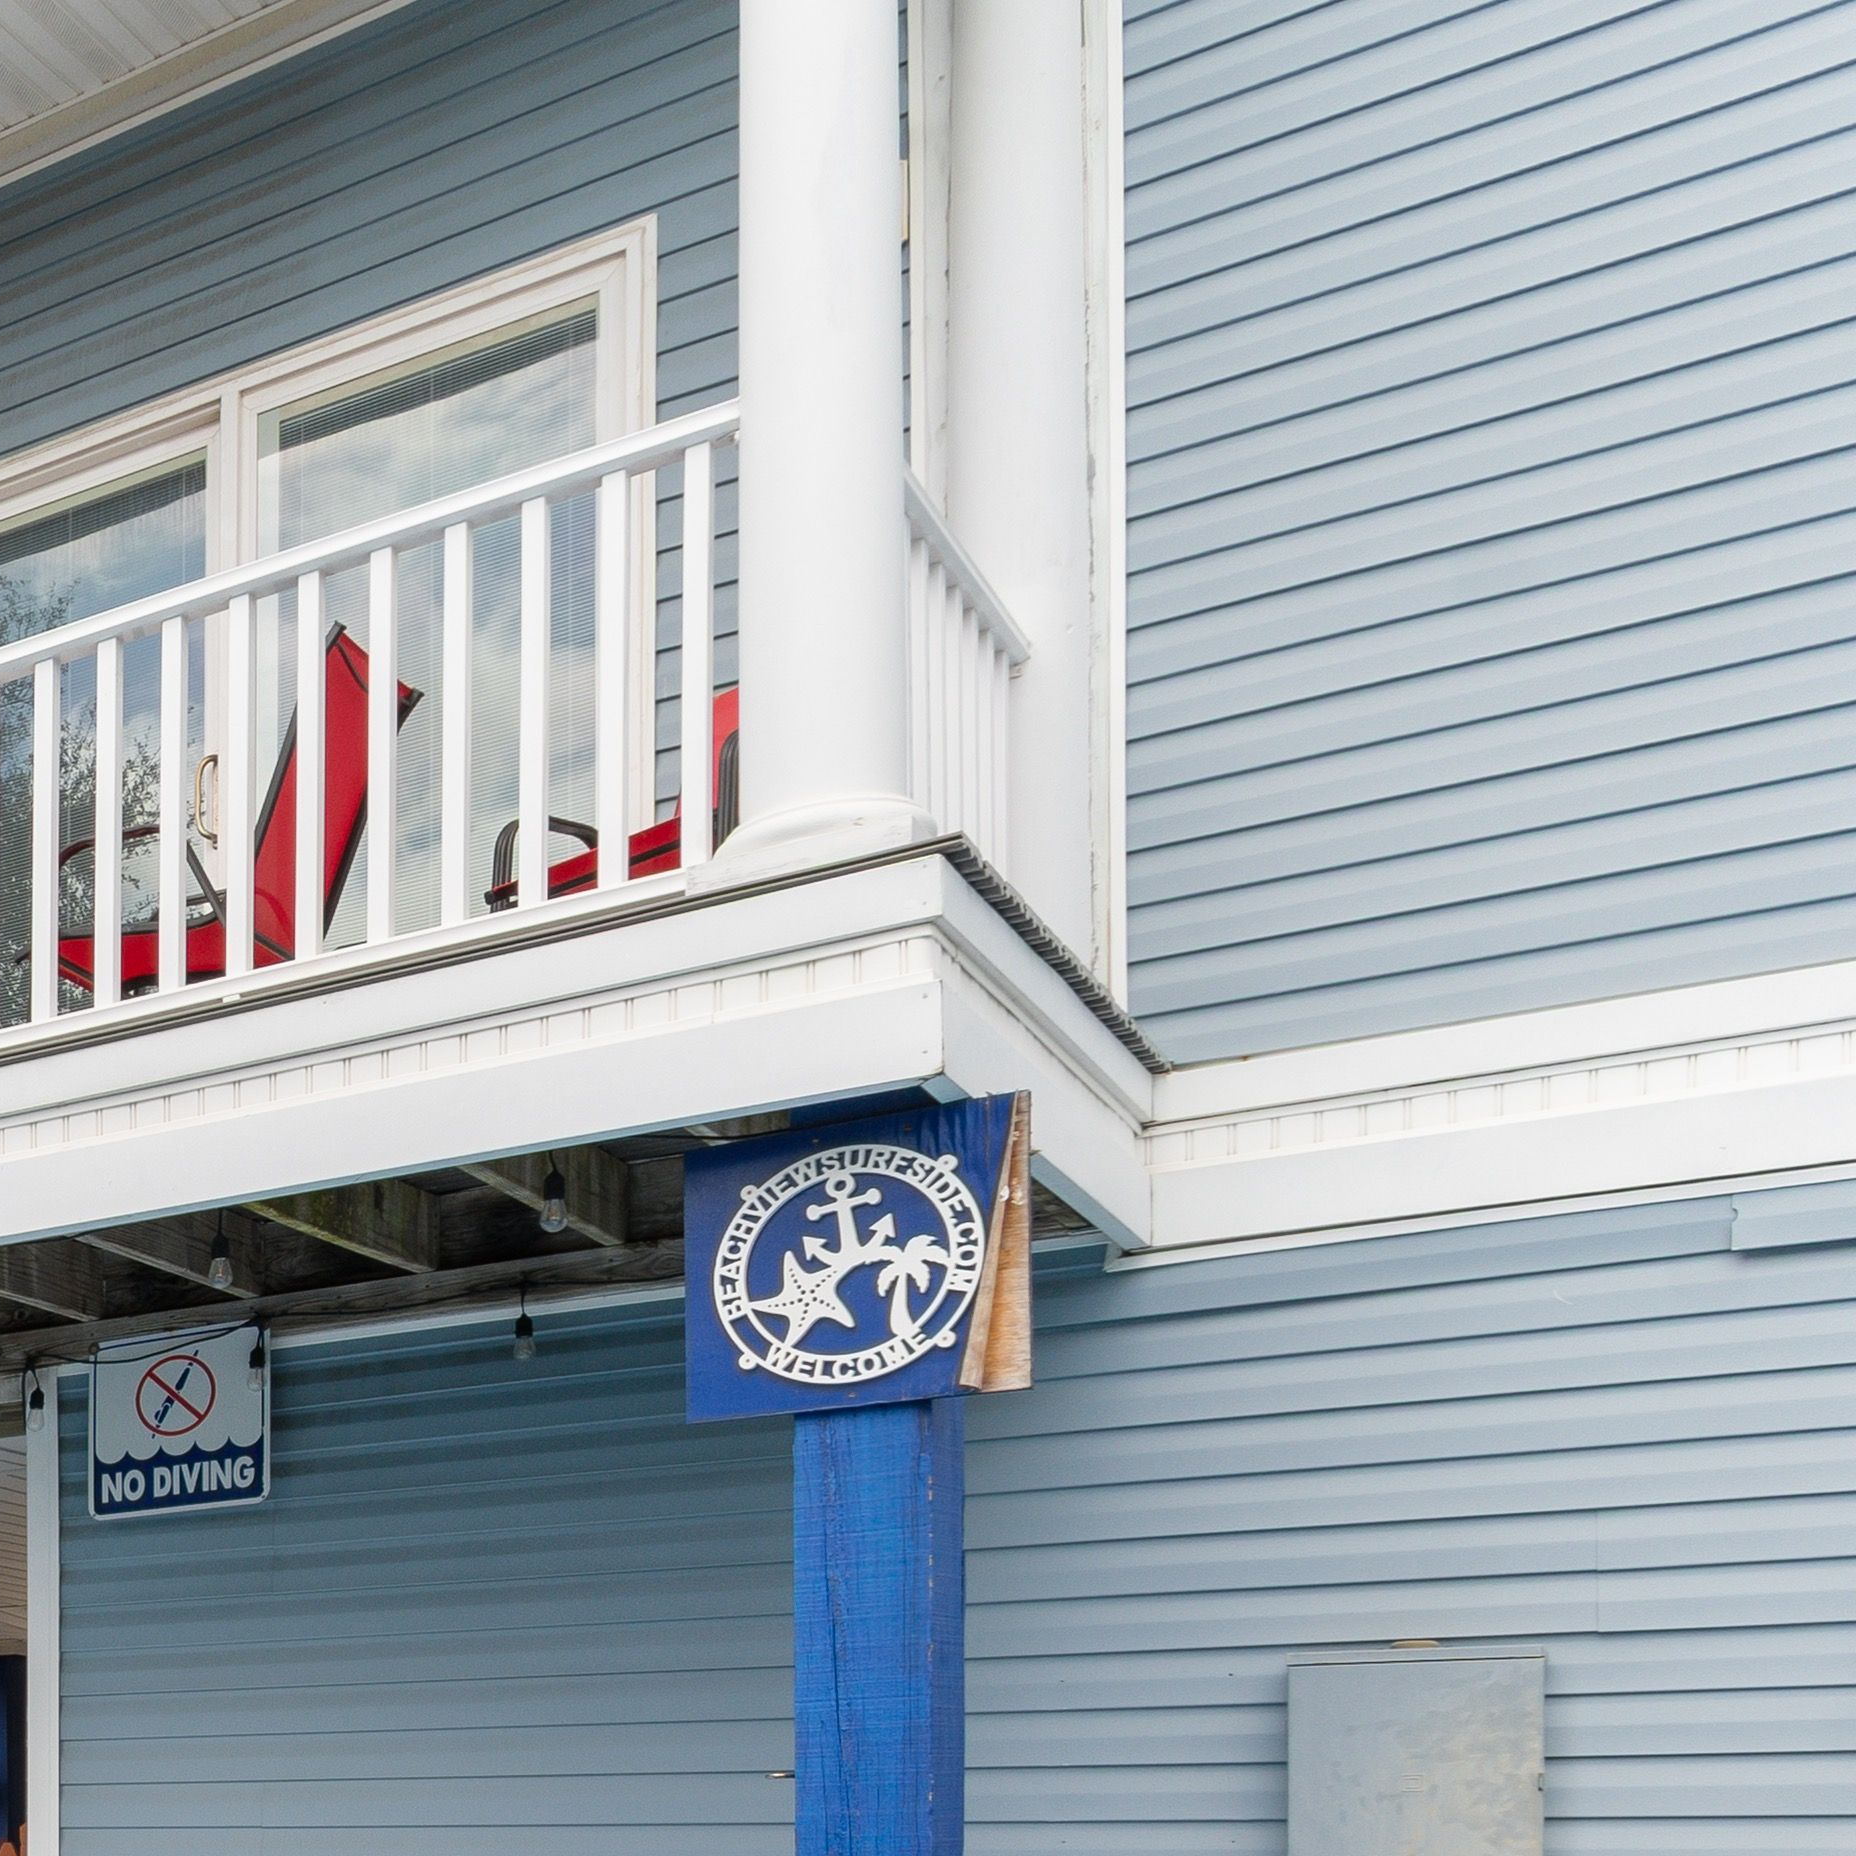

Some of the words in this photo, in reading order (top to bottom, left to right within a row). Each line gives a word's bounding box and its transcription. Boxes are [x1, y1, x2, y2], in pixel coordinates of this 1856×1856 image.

[766, 1331, 929, 1379] WELCOME
[101, 1469, 146, 1504] NO
[153, 1455, 256, 1499] DIVING
